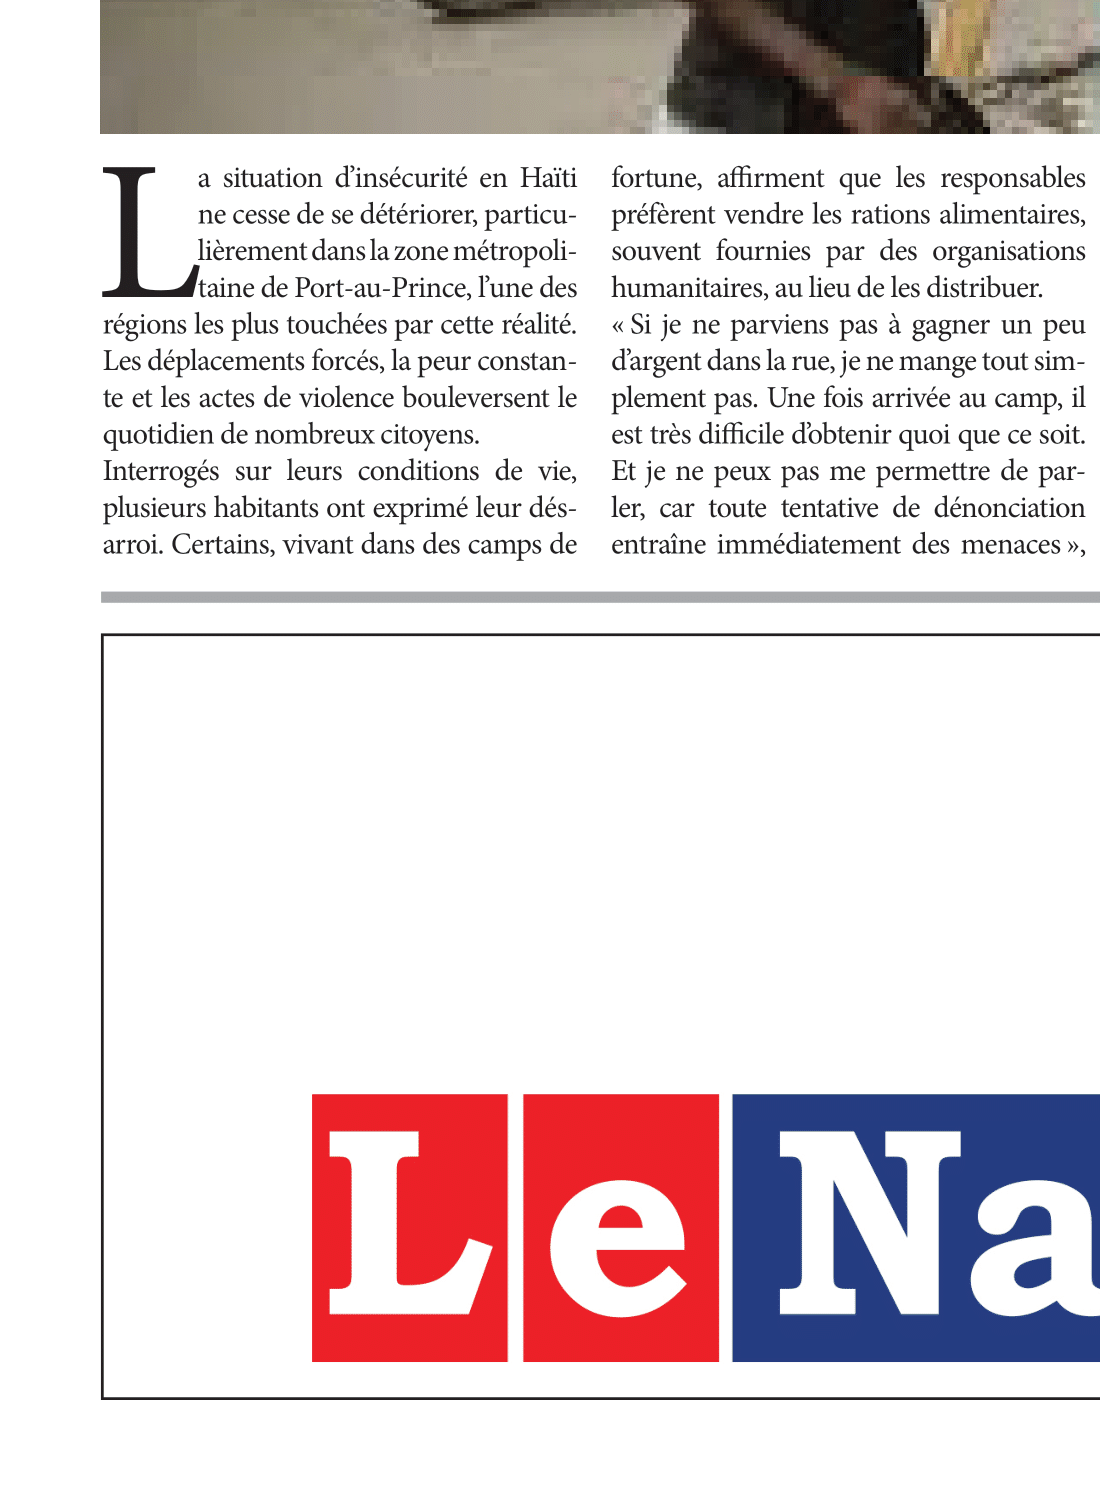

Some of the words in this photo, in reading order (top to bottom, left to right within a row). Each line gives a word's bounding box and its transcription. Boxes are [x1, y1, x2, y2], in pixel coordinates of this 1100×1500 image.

[198, 172, 212, 188] a
[223, 167, 323, 188] situation
[335, 164, 468, 188] d’insécurité
[479, 172, 508, 188] en
[520, 166, 578, 188] Haïti
[611, 164, 703, 191] fortune,
[717, 164, 825, 188] affirment
[839, 172, 882, 195] que
[895, 165, 926, 188] les
[940, 164, 1086, 195] responsables
[611, 201, 716, 232] préfèrent
[723, 201, 804, 225] vendre
[812, 201, 842, 225] les
[851, 203, 931, 225] rations
[939, 201, 1086, 228] alimentaires,
[611, 274, 769, 301] humanitaires,
[775, 282, 803, 298] au
[808, 275, 851, 298] lieu
[857, 274, 885, 298] de
[890, 275, 921, 298] les
[926, 274, 1043, 298] distribuer.
[103, 312, 187, 342] régions
[194, 311, 224, 335] les
[231, 311, 279, 342] plus
[286, 311, 388, 335] touchées
[394, 319, 434, 342] par
[440, 315, 494, 335] cette
[501, 311, 577, 335] réalité.
[103, 349, 142, 371] Les
[147, 347, 305, 378] déplacements
[311, 347, 385, 374] forcés,
[391, 347, 412, 371] la
[417, 355, 472, 378] peur
[477, 352, 577, 371] constan-
[611, 384, 707, 415] plement
[713, 392, 758, 415] pas.
[767, 386, 816, 408] Une
[823, 384, 864, 408] fois
[872, 386, 951, 408] arrivée
[959, 392, 987, 408] au
[994, 392, 1063, 415] camp,
[1071, 385, 1087, 408] il
[103, 421, 214, 452] quotidien
[220, 421, 249, 445] de
[254, 421, 375, 445] nombreux
[380, 423, 480, 452] citoyens.
[611, 494, 646, 521] ler,
[659, 502, 695, 518] car
[708, 499, 767, 518] toute
[780, 497, 879, 518] tentative
[892, 494, 921, 518] de
[934, 494, 1086, 518] dénonciation
[103, 533, 164, 555] arroi.
[171, 532, 276, 558] Certains,
[282, 533, 354, 555] vivant
[361, 531, 415, 555] dans
[422, 531, 461, 555] des
[468, 539, 542, 562] camps
[549, 531, 578, 555] de
